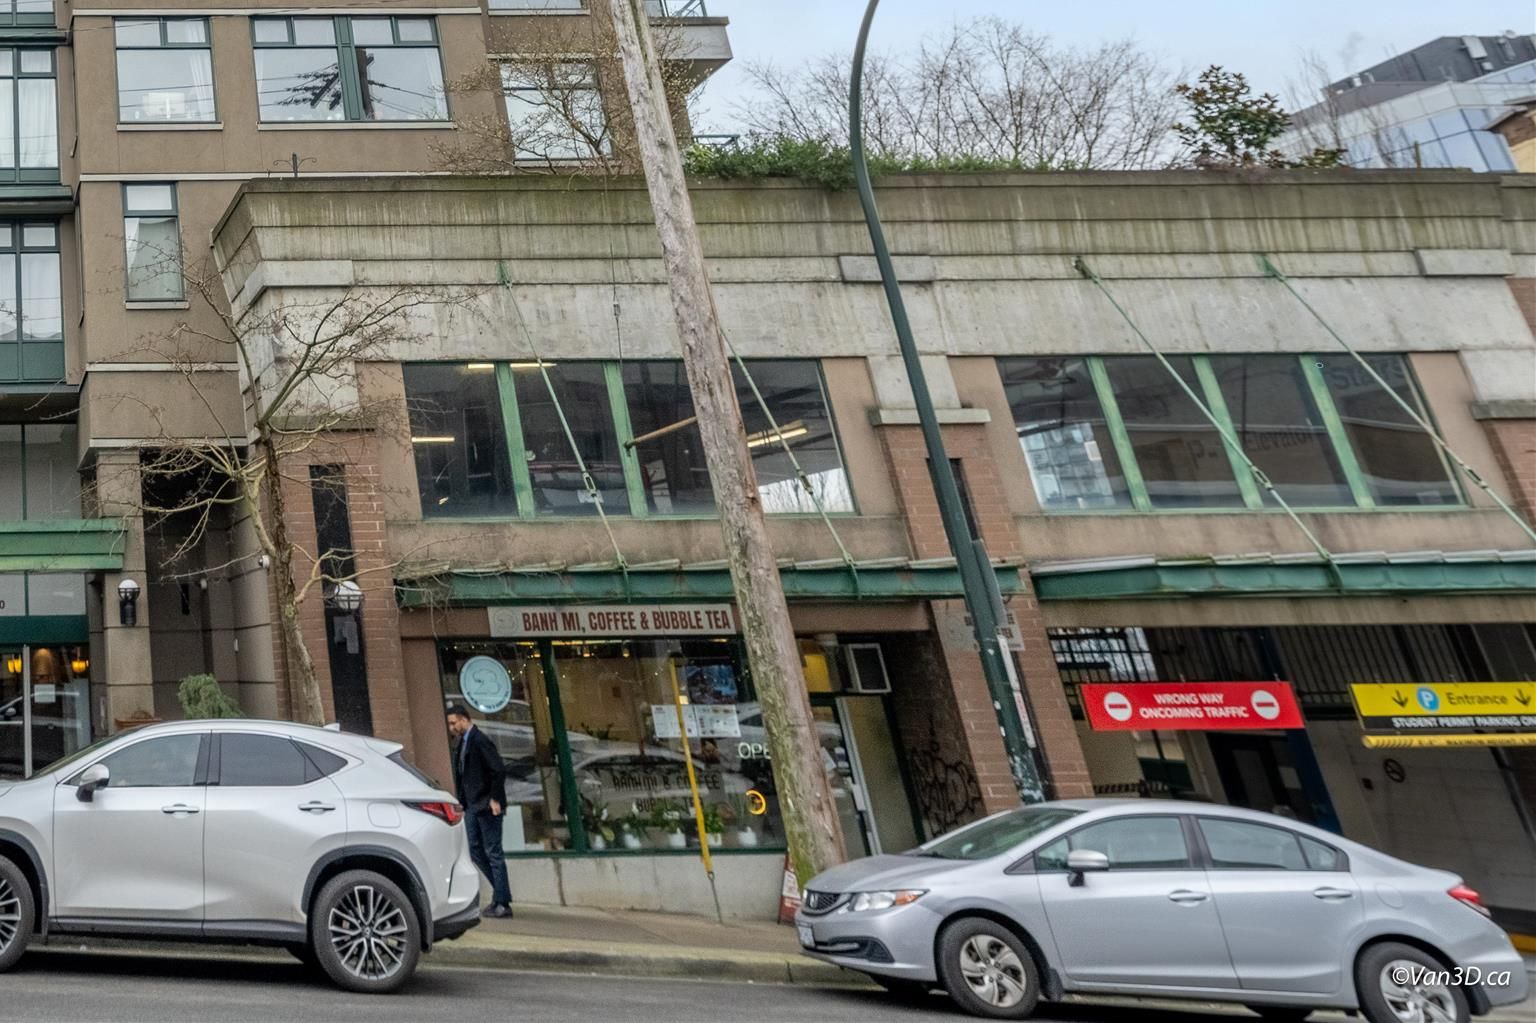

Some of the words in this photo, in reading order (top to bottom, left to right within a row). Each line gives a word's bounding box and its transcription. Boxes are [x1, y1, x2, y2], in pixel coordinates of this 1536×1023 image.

[522, 612, 559, 632] BANH
[562, 612, 586, 633] MI,
[588, 611, 637, 631] COFFEE
[640, 611, 649, 630] &
[652, 610, 702, 630] BUBBLE
[705, 610, 732, 629] TEA
[1153, 693, 1199, 705] WRONG
[1199, 693, 1225, 704] WAY
[1446, 692, 1509, 705] Entrance
[1139, 707, 1204, 719] ONCOMING
[1204, 706, 1250, 718] TRAFFIC
[1392, 717, 1439, 728] STUDENT
[1438, 717, 1476, 727] PERMIT
[1475, 716, 1521, 727] PARKING
[738, 741, 772, 760] OPE
